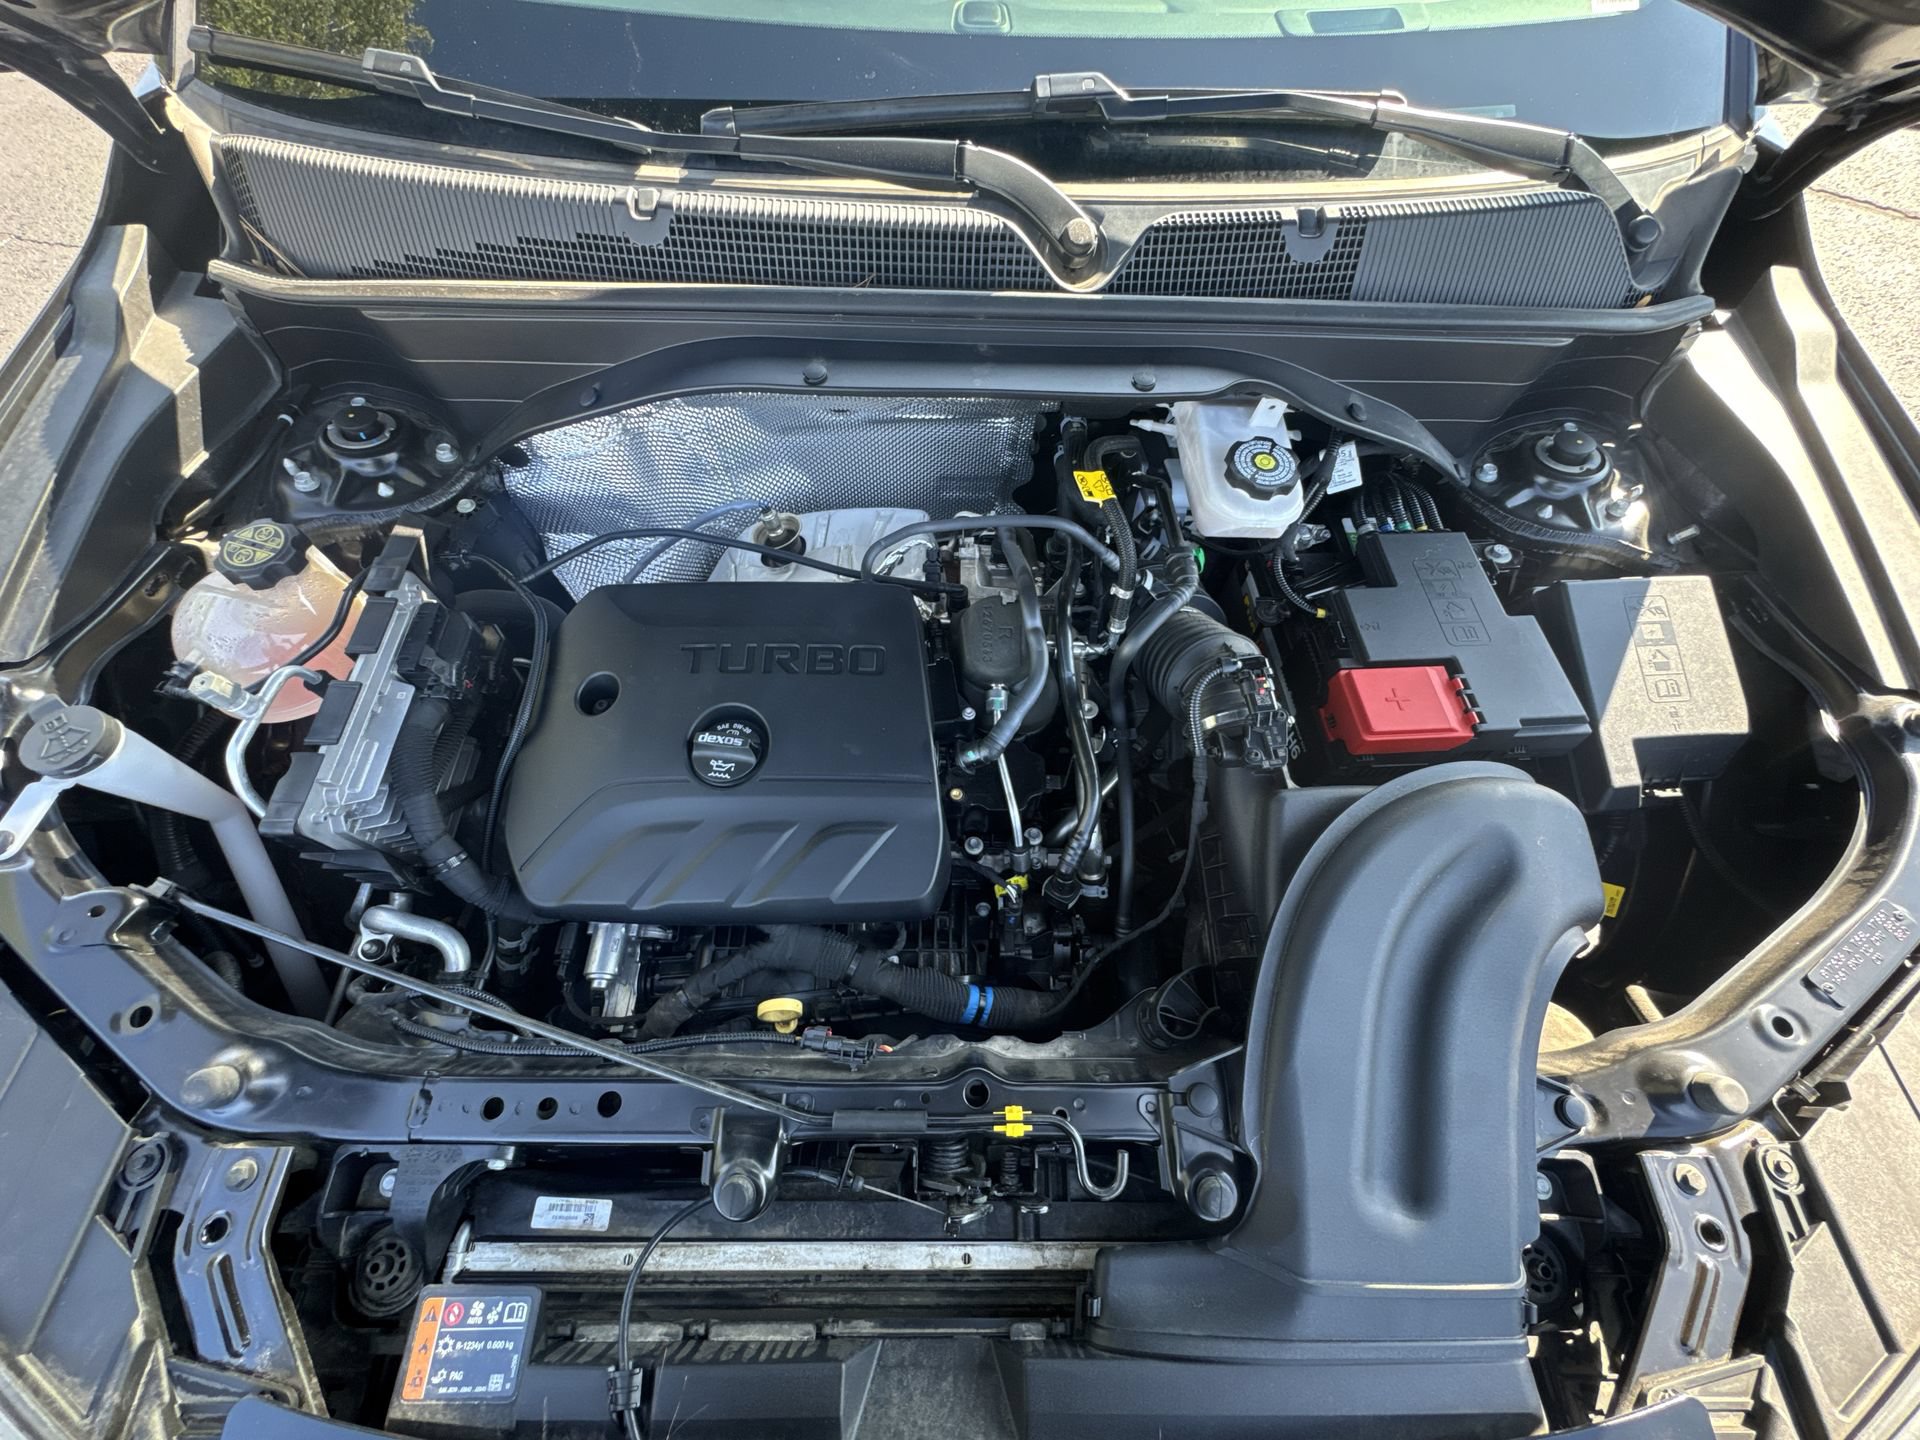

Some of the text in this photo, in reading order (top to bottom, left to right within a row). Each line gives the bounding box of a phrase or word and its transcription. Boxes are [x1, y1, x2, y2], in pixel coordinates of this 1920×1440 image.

[680, 643, 886, 675] TURBO
[716, 723, 730, 731] SAE
[698, 732, 745, 746] dexos
[467, 1316, 483, 1325] AUTO
[505, 1341, 514, 1351] kg
[449, 1371, 464, 1381] PAG
